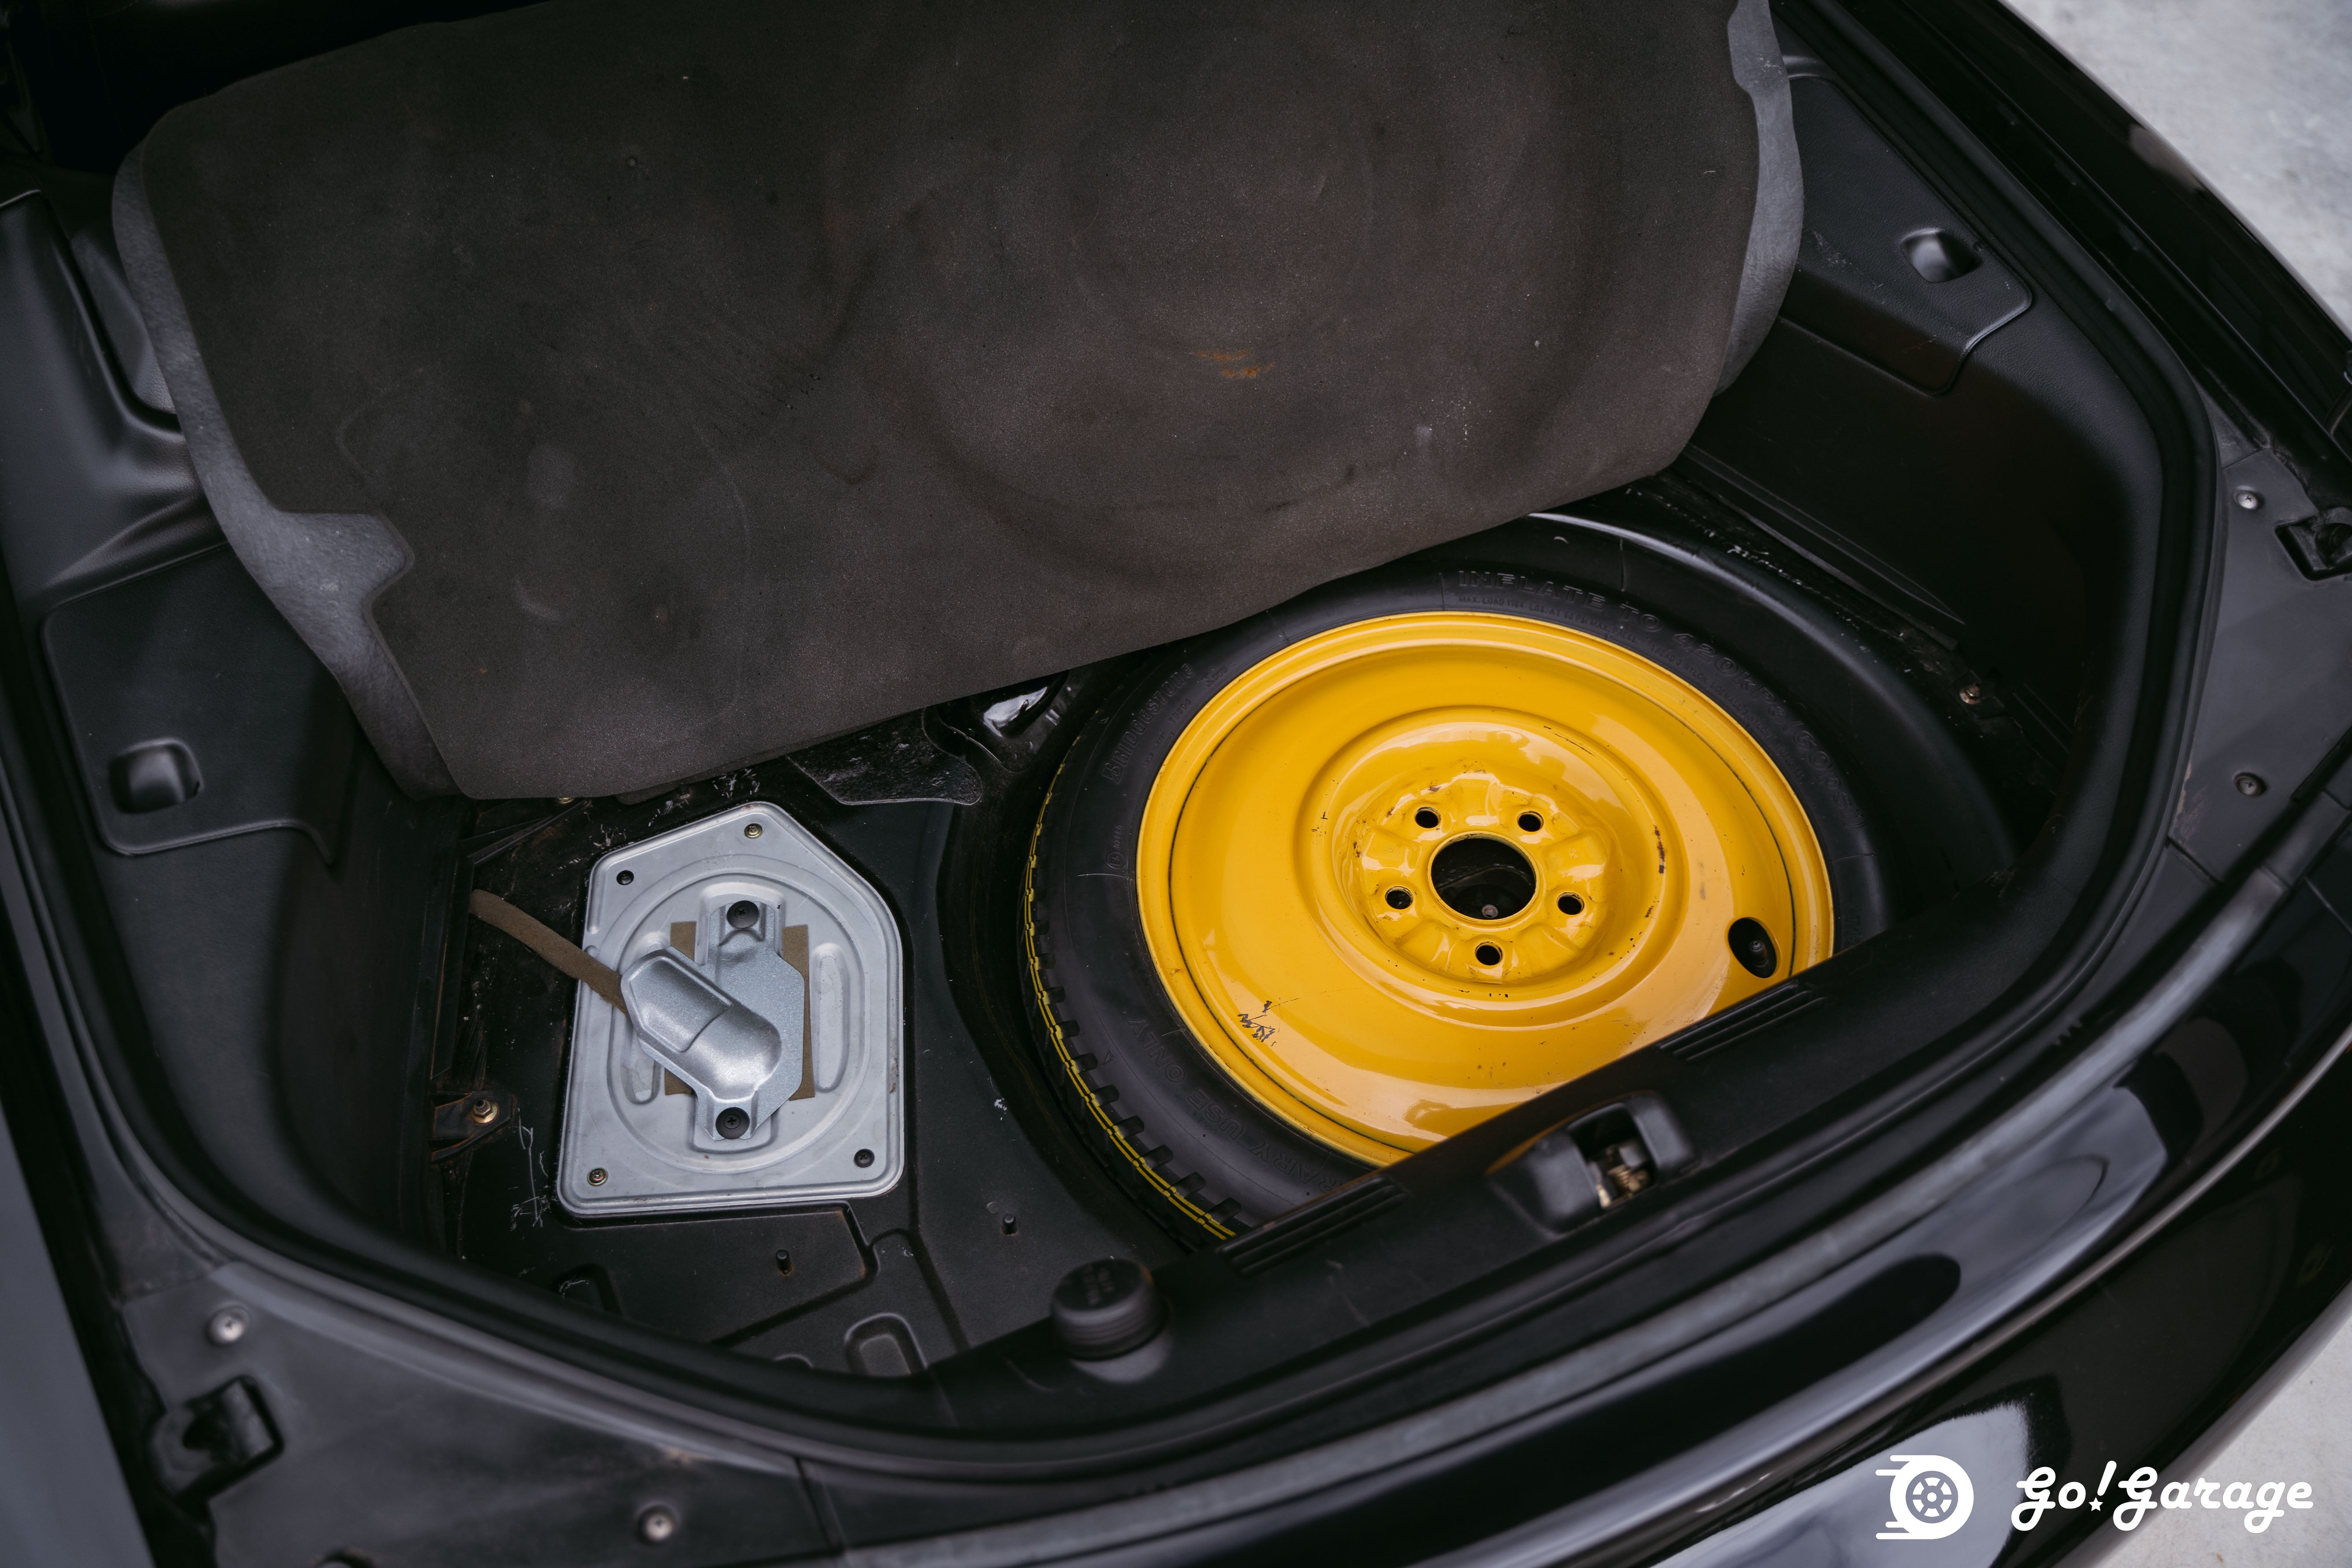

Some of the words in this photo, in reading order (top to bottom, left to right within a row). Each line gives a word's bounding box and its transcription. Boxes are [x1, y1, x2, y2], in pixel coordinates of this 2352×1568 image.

[1459, 570, 1606, 612] INFLATE
[1619, 603, 1664, 633] TO
[1459, 596, 1480, 604] MAX.
[1482, 597, 1504, 606] LOAD
[1549, 608, 1562, 617] AT
[1575, 615, 1590, 625] PSI
[1649, 645, 1675, 662] TREAD
[1100, 661, 1196, 785] BRIDGESTONE
[1125, 1016, 1186, 1086] ONLY
[1187, 1087, 1244, 1141] USE
[1249, 1140, 1344, 1194] RARY
